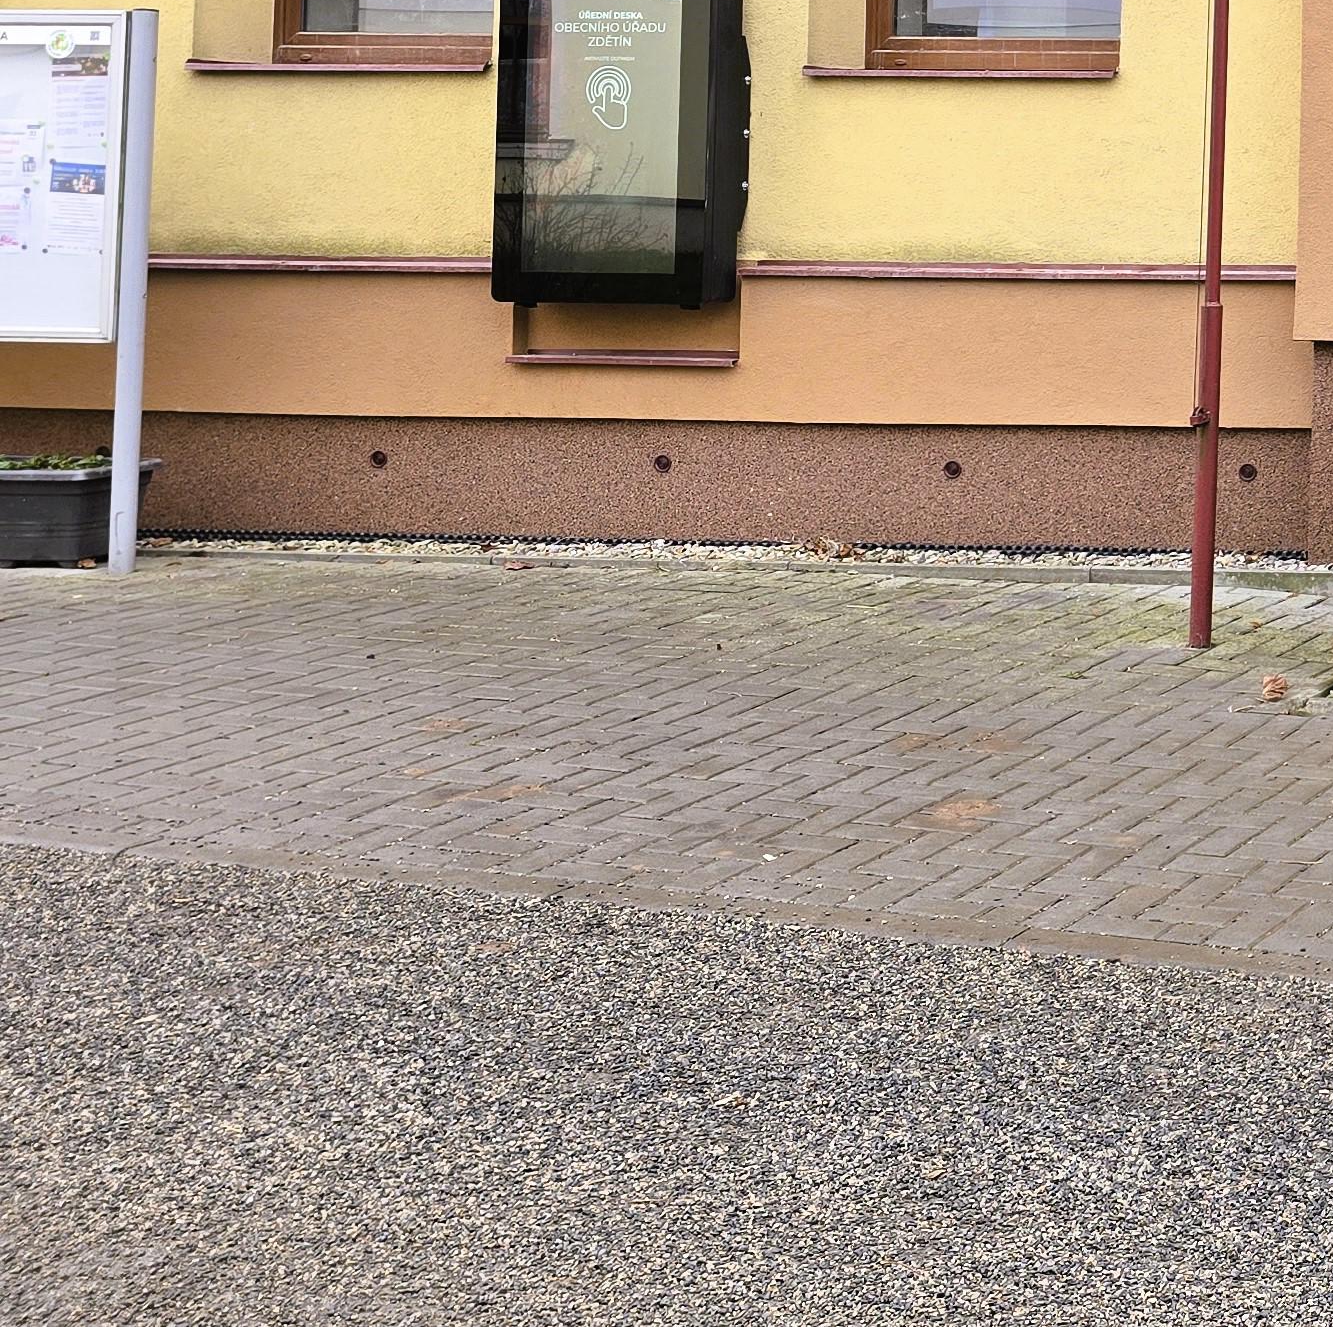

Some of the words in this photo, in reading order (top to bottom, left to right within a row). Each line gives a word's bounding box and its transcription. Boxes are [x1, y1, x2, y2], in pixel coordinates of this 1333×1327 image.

[578, 9, 613, 20] ÚŘEDNÍ
[614, 11, 643, 20] DESKA
[554, 20, 620, 33] OBECNÍHO
[622, 20, 666, 33] ÚŘADU
[588, 34, 632, 47] ZDĚTÍN
